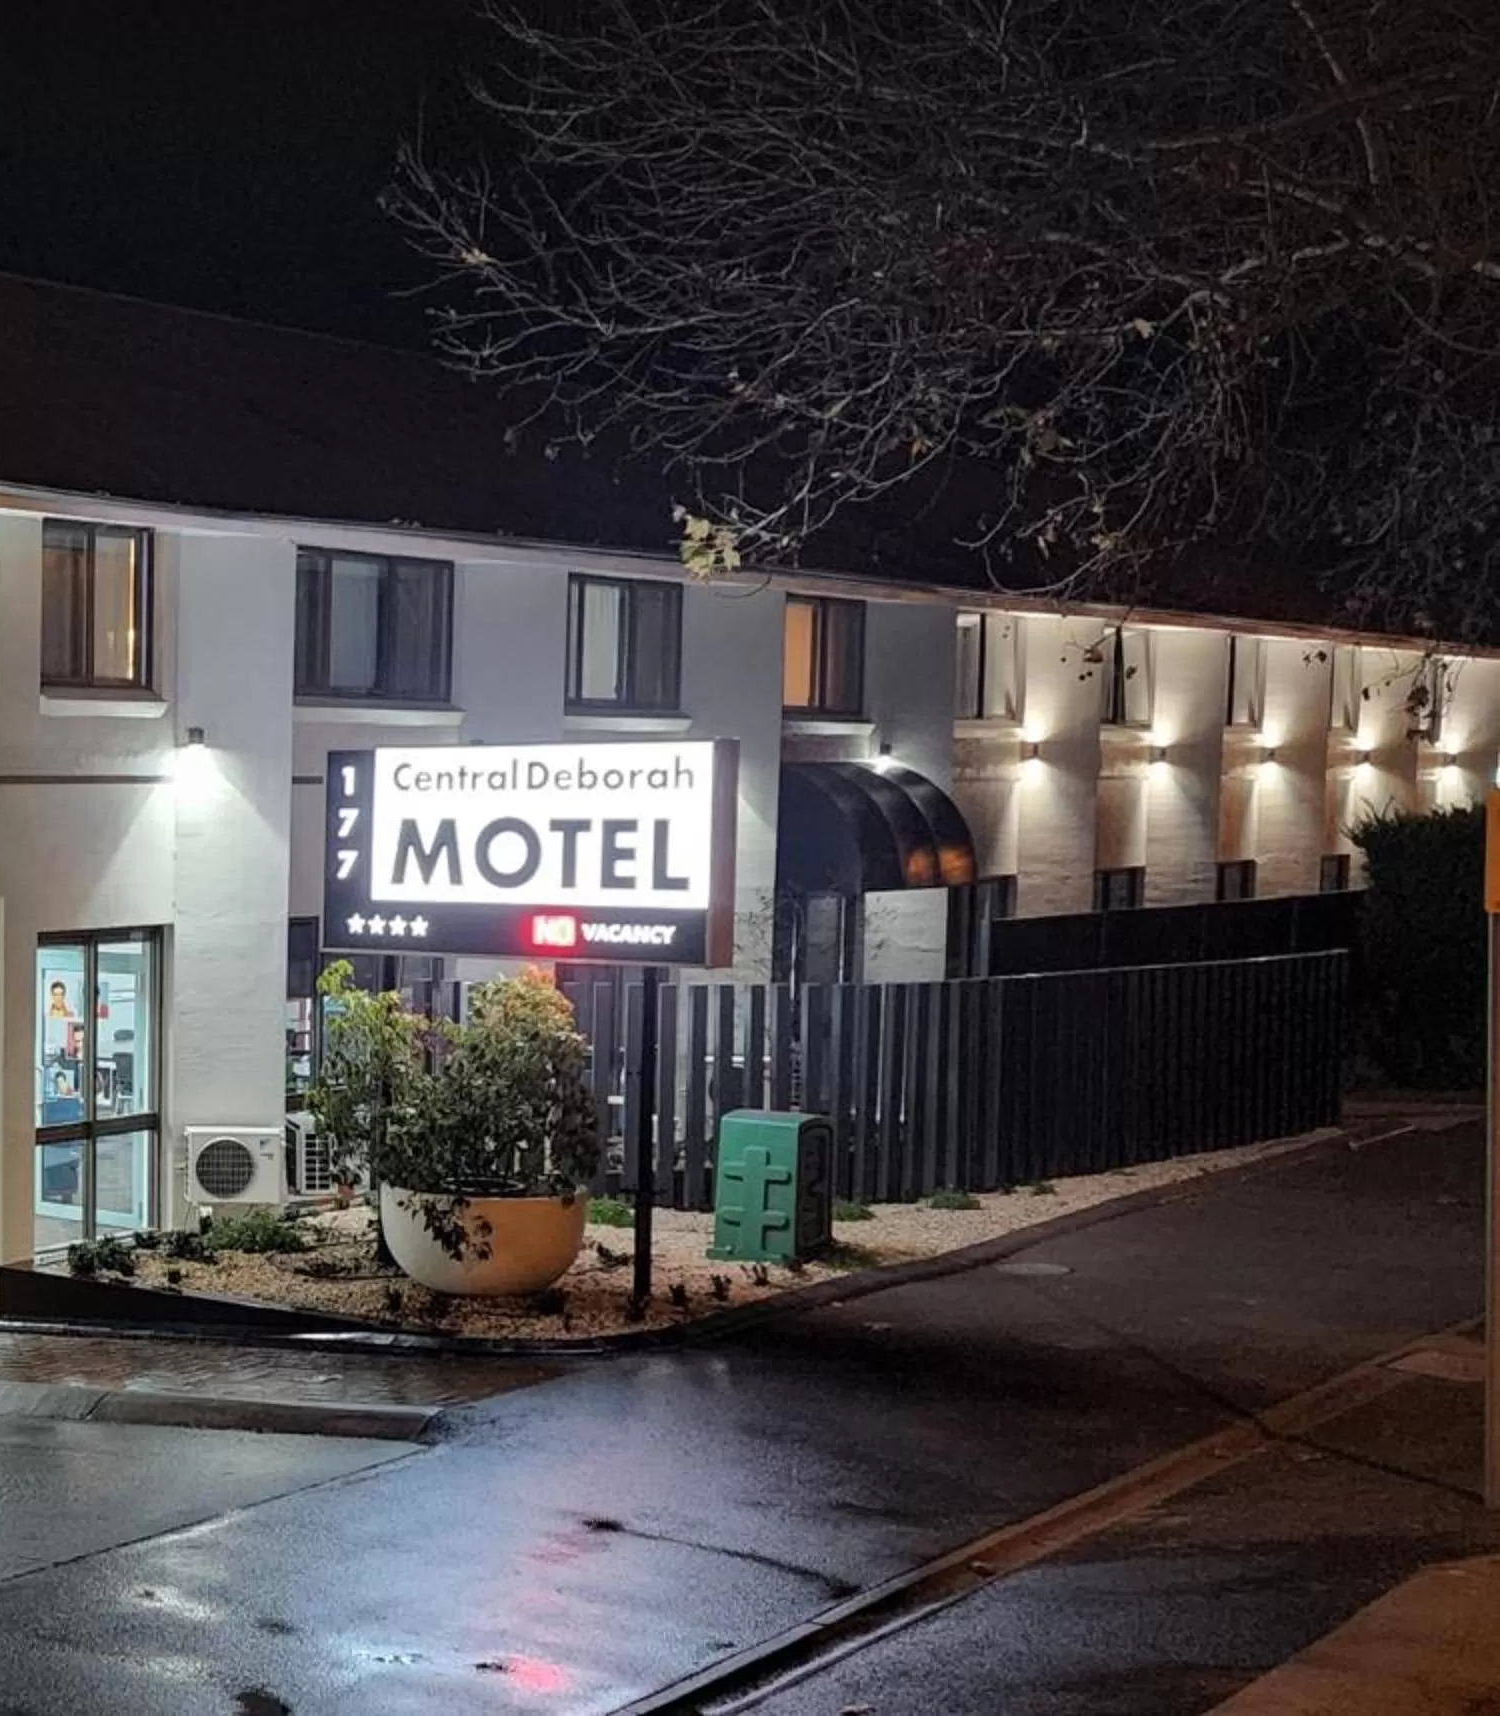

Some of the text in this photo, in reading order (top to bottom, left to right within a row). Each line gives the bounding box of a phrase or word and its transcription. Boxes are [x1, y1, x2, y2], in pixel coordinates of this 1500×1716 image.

[390, 816, 690, 891] MOTEL
[532, 915, 677, 946] NO VACANCY
